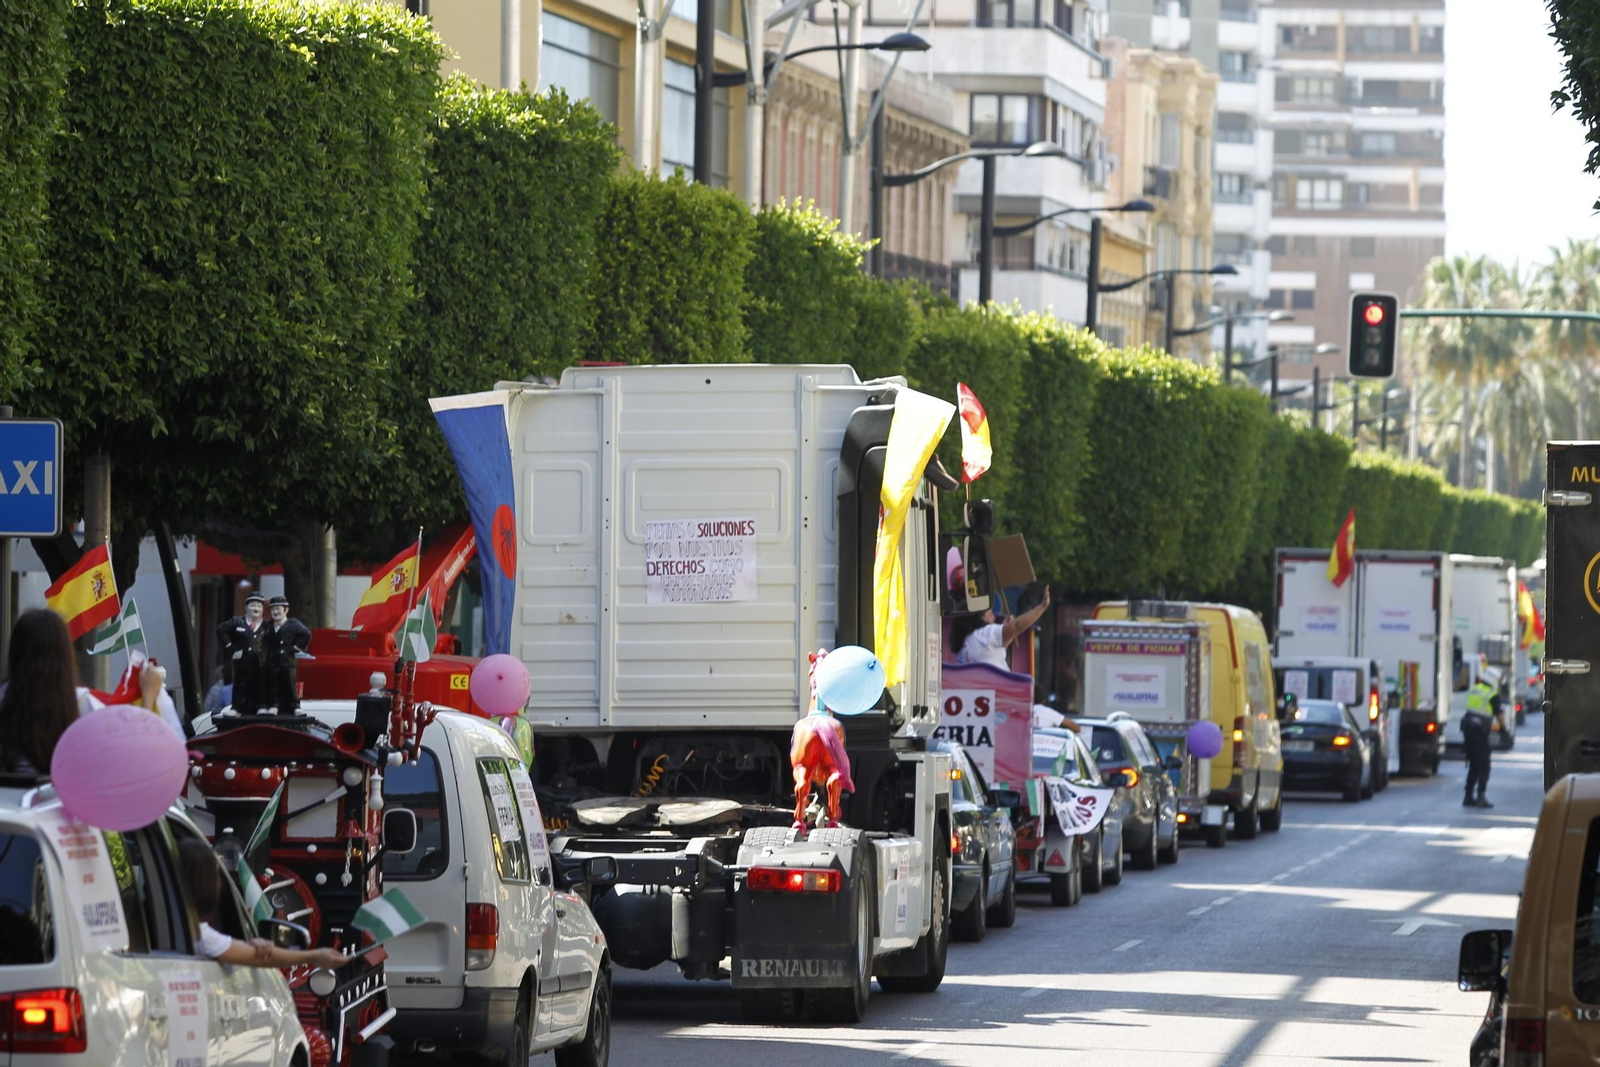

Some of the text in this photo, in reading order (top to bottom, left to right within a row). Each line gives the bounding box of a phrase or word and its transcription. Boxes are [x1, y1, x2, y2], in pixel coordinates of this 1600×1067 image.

[0, 461, 53, 495] XI
[697, 520, 755, 538] SOLUCIONES
[646, 539, 744, 559] POR NUESTROS
[646, 558, 744, 576] DERECHOS COMO
[1090, 642, 1123, 653] VENTA
[1127, 643, 1140, 653] DE
[741, 959, 847, 978] RENAULT
